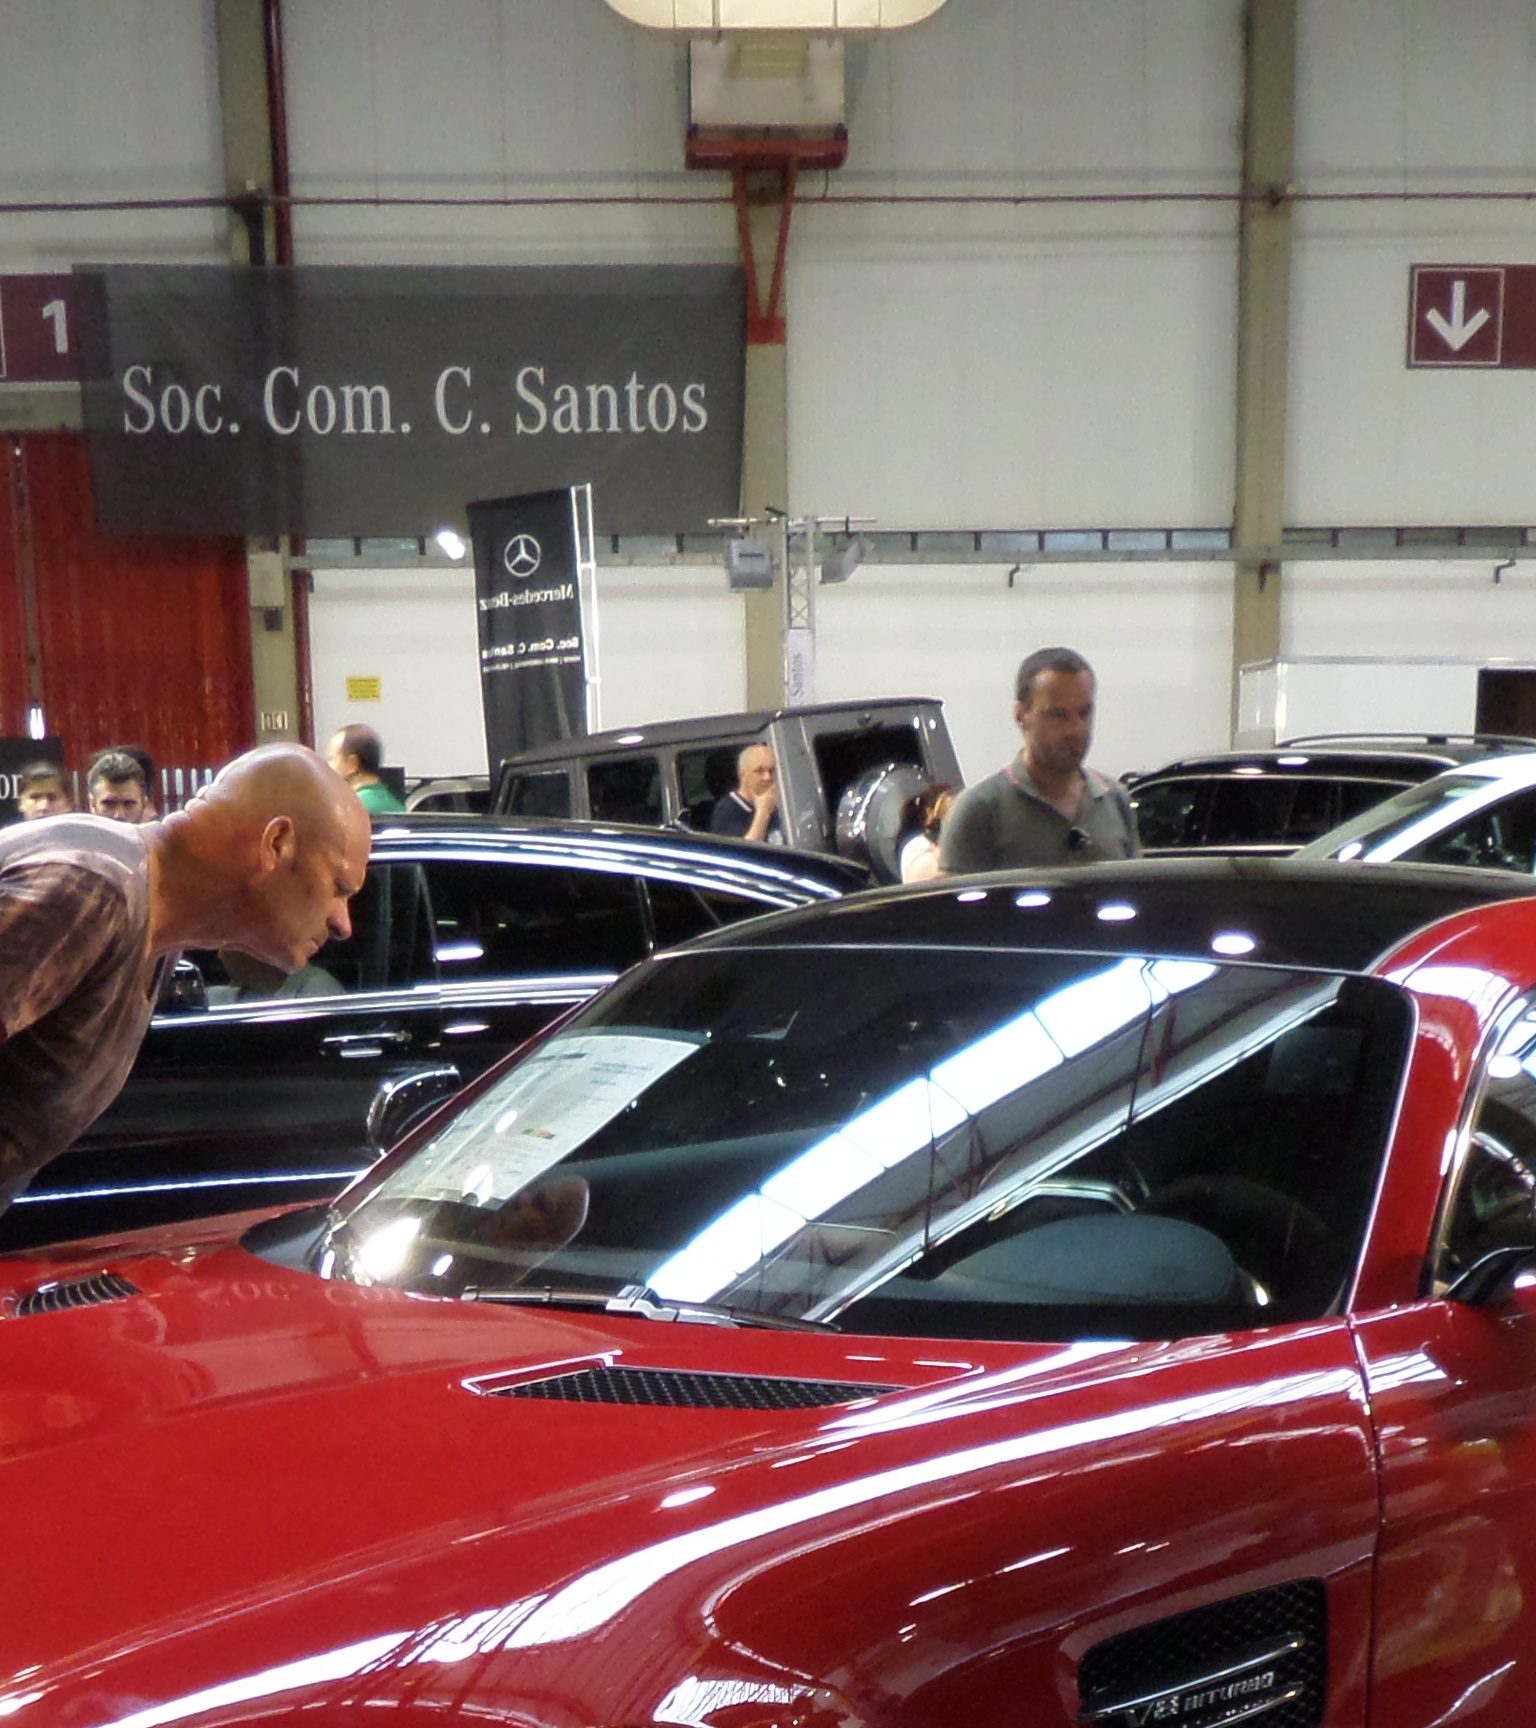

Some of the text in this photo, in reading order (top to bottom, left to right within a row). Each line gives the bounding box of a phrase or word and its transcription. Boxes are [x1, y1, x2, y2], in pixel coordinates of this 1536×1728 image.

[42, 299, 68, 353] 1
[122, 365, 708, 435] Soc. Com. C. Santos
